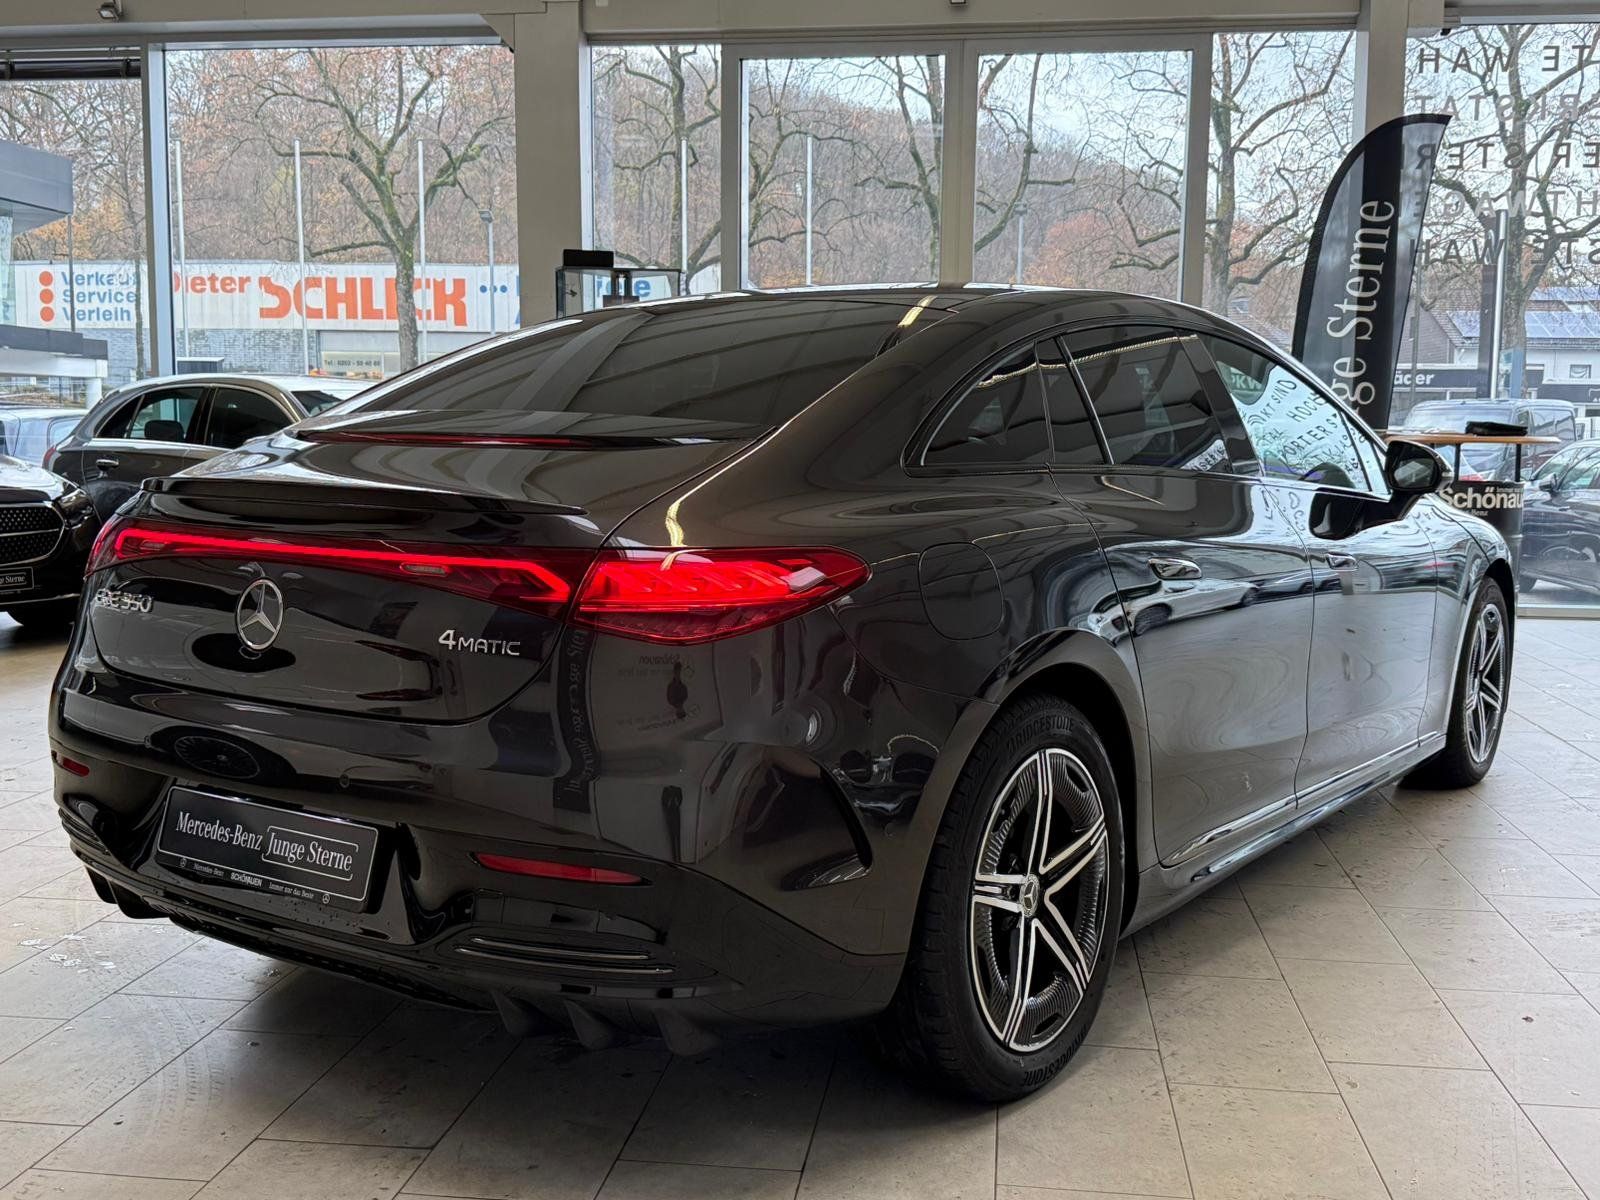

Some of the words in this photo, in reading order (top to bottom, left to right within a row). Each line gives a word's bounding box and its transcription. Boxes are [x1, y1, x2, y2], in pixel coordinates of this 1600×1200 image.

[61, 271, 138, 287] Verkau
[1325, 200, 1396, 340] Sterne
[62, 288, 138, 304] Service
[1328, 356, 1376, 414] ge
[438, 629, 521, 656] 4MATIC
[175, 811, 264, 851] Mercedes-Benz
[264, 831, 305, 864] Junge
[306, 840, 353, 871] Sterne
